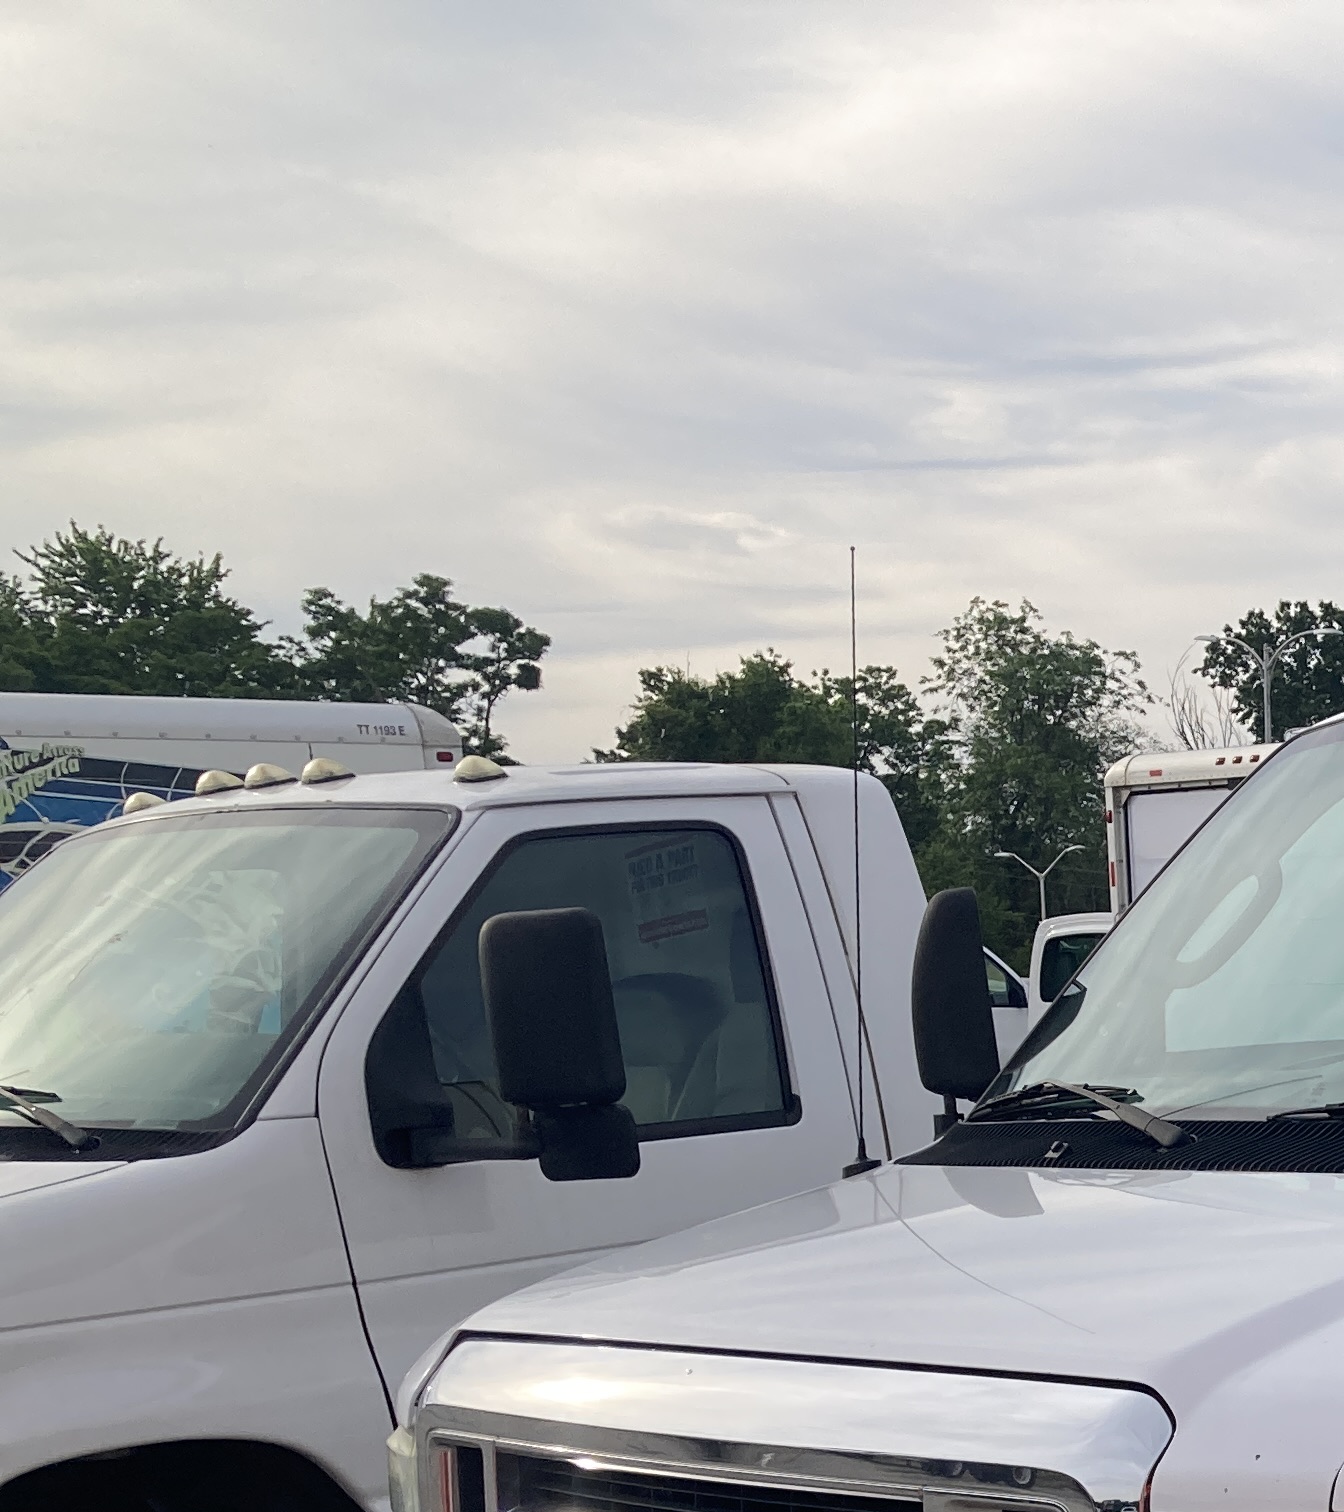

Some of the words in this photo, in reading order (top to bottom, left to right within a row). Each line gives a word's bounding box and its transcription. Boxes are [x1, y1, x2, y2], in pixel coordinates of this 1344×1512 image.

[357, 724, 370, 735] TT
[373, 725, 397, 736] 1193
[398, 725, 406, 736] E
